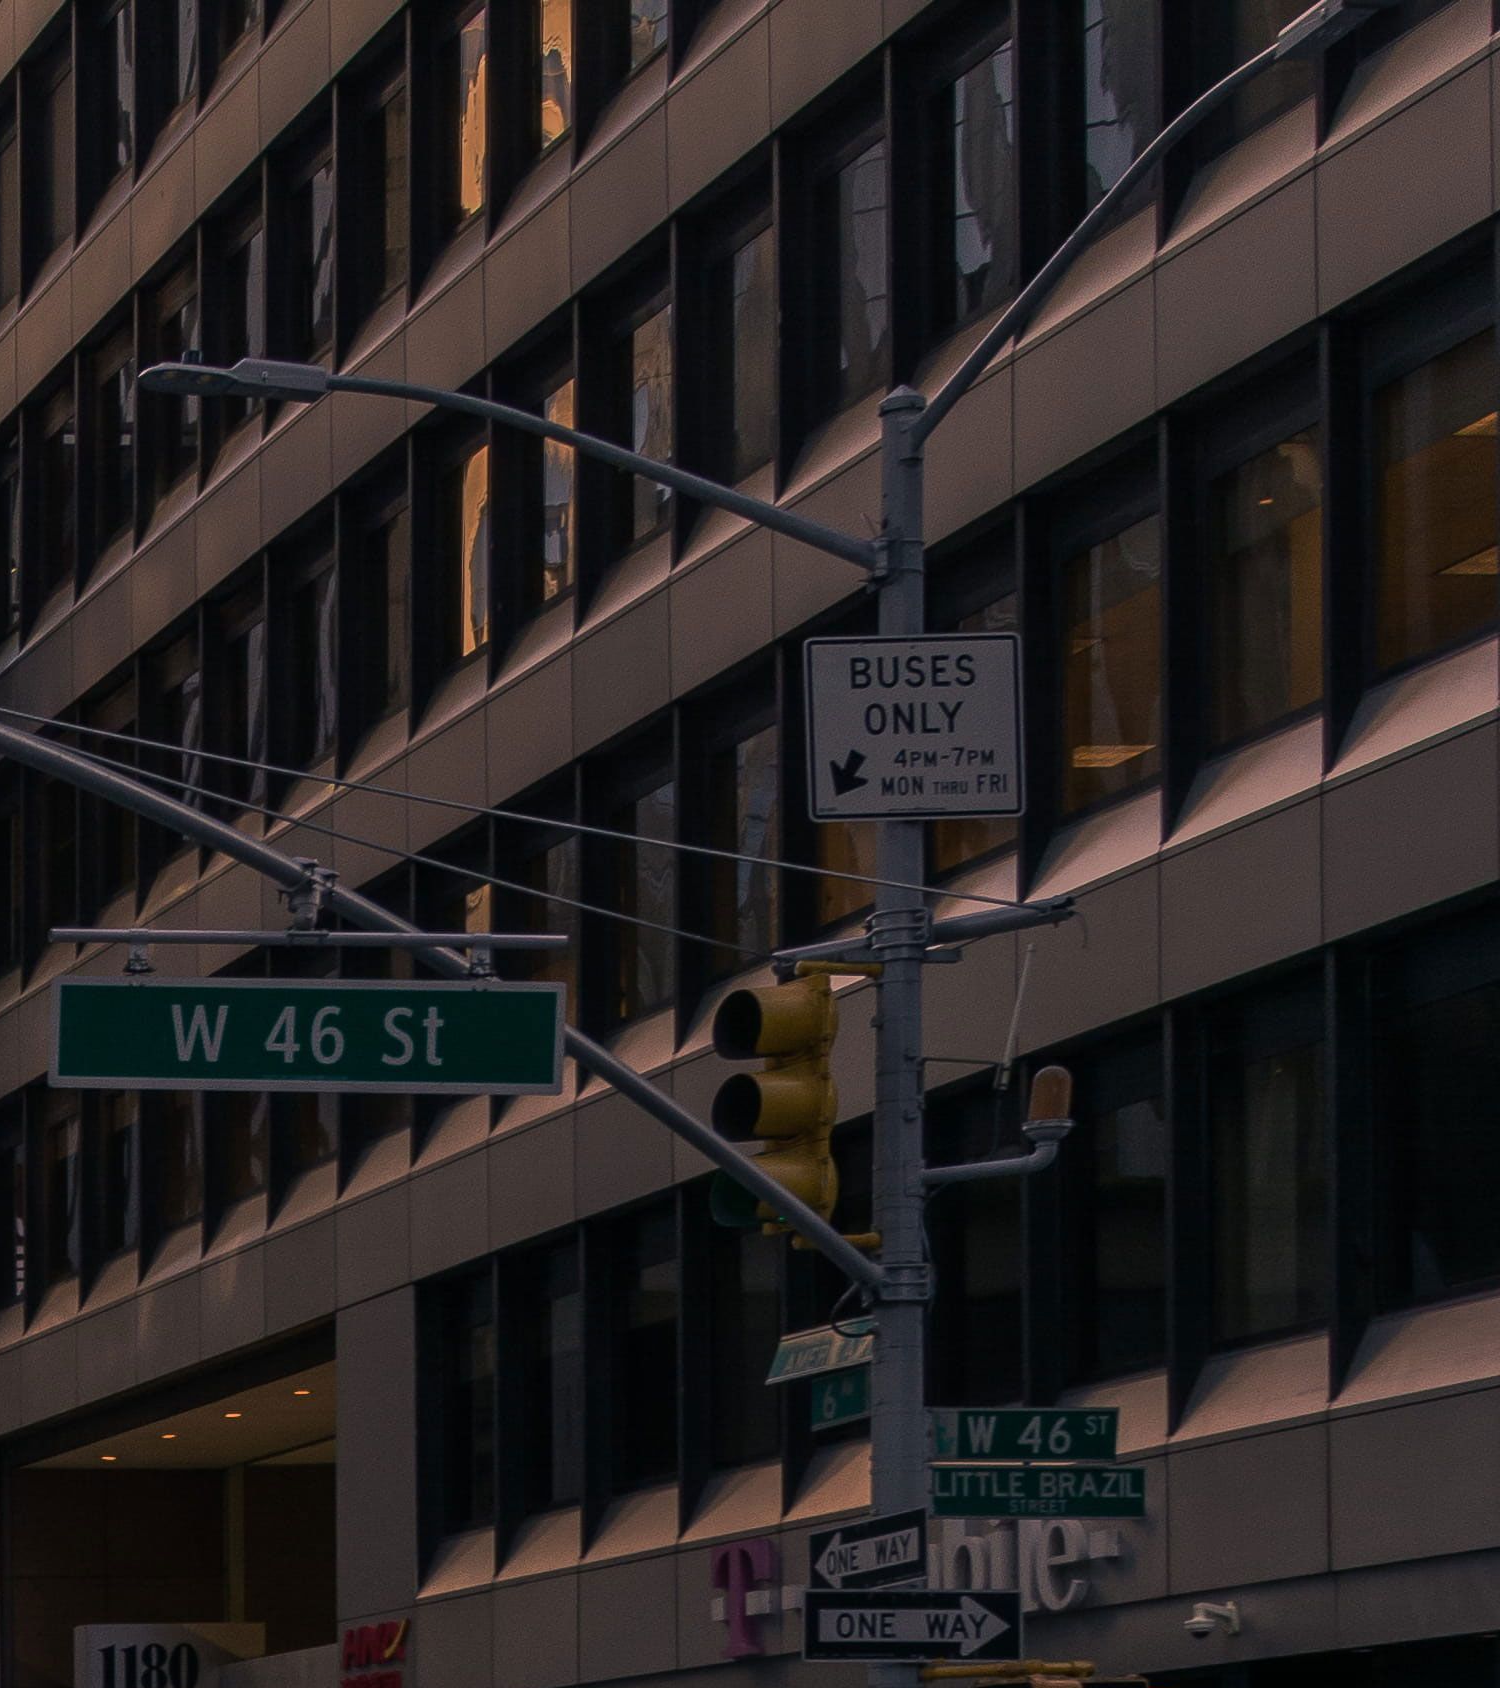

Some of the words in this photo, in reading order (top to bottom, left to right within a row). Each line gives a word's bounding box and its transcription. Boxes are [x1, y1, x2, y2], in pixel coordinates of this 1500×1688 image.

[850, 654, 976, 690] BUSES
[865, 701, 964, 735] ONLY
[894, 747, 995, 768] 4PM-7PM
[881, 776, 924, 796] MON
[933, 781, 968, 795] THRU
[977, 774, 1008, 793] FRI
[171, 1003, 229, 1064] W
[264, 1004, 346, 1065] 46
[381, 1005, 445, 1067] St
[967, 1415, 996, 1454] W
[1016, 1415, 1073, 1455] 46
[1084, 1414, 1110, 1435] ST
[934, 1471, 1026, 1499] LITTLE
[1038, 1471, 1143, 1499] BRAZIL
[1009, 1499, 1067, 1514] STREET
[826, 1545, 859, 1576] ONE
[874, 1534, 912, 1565] WAY
[836, 1613, 897, 1639] ONE
[925, 1613, 989, 1639] WAY
